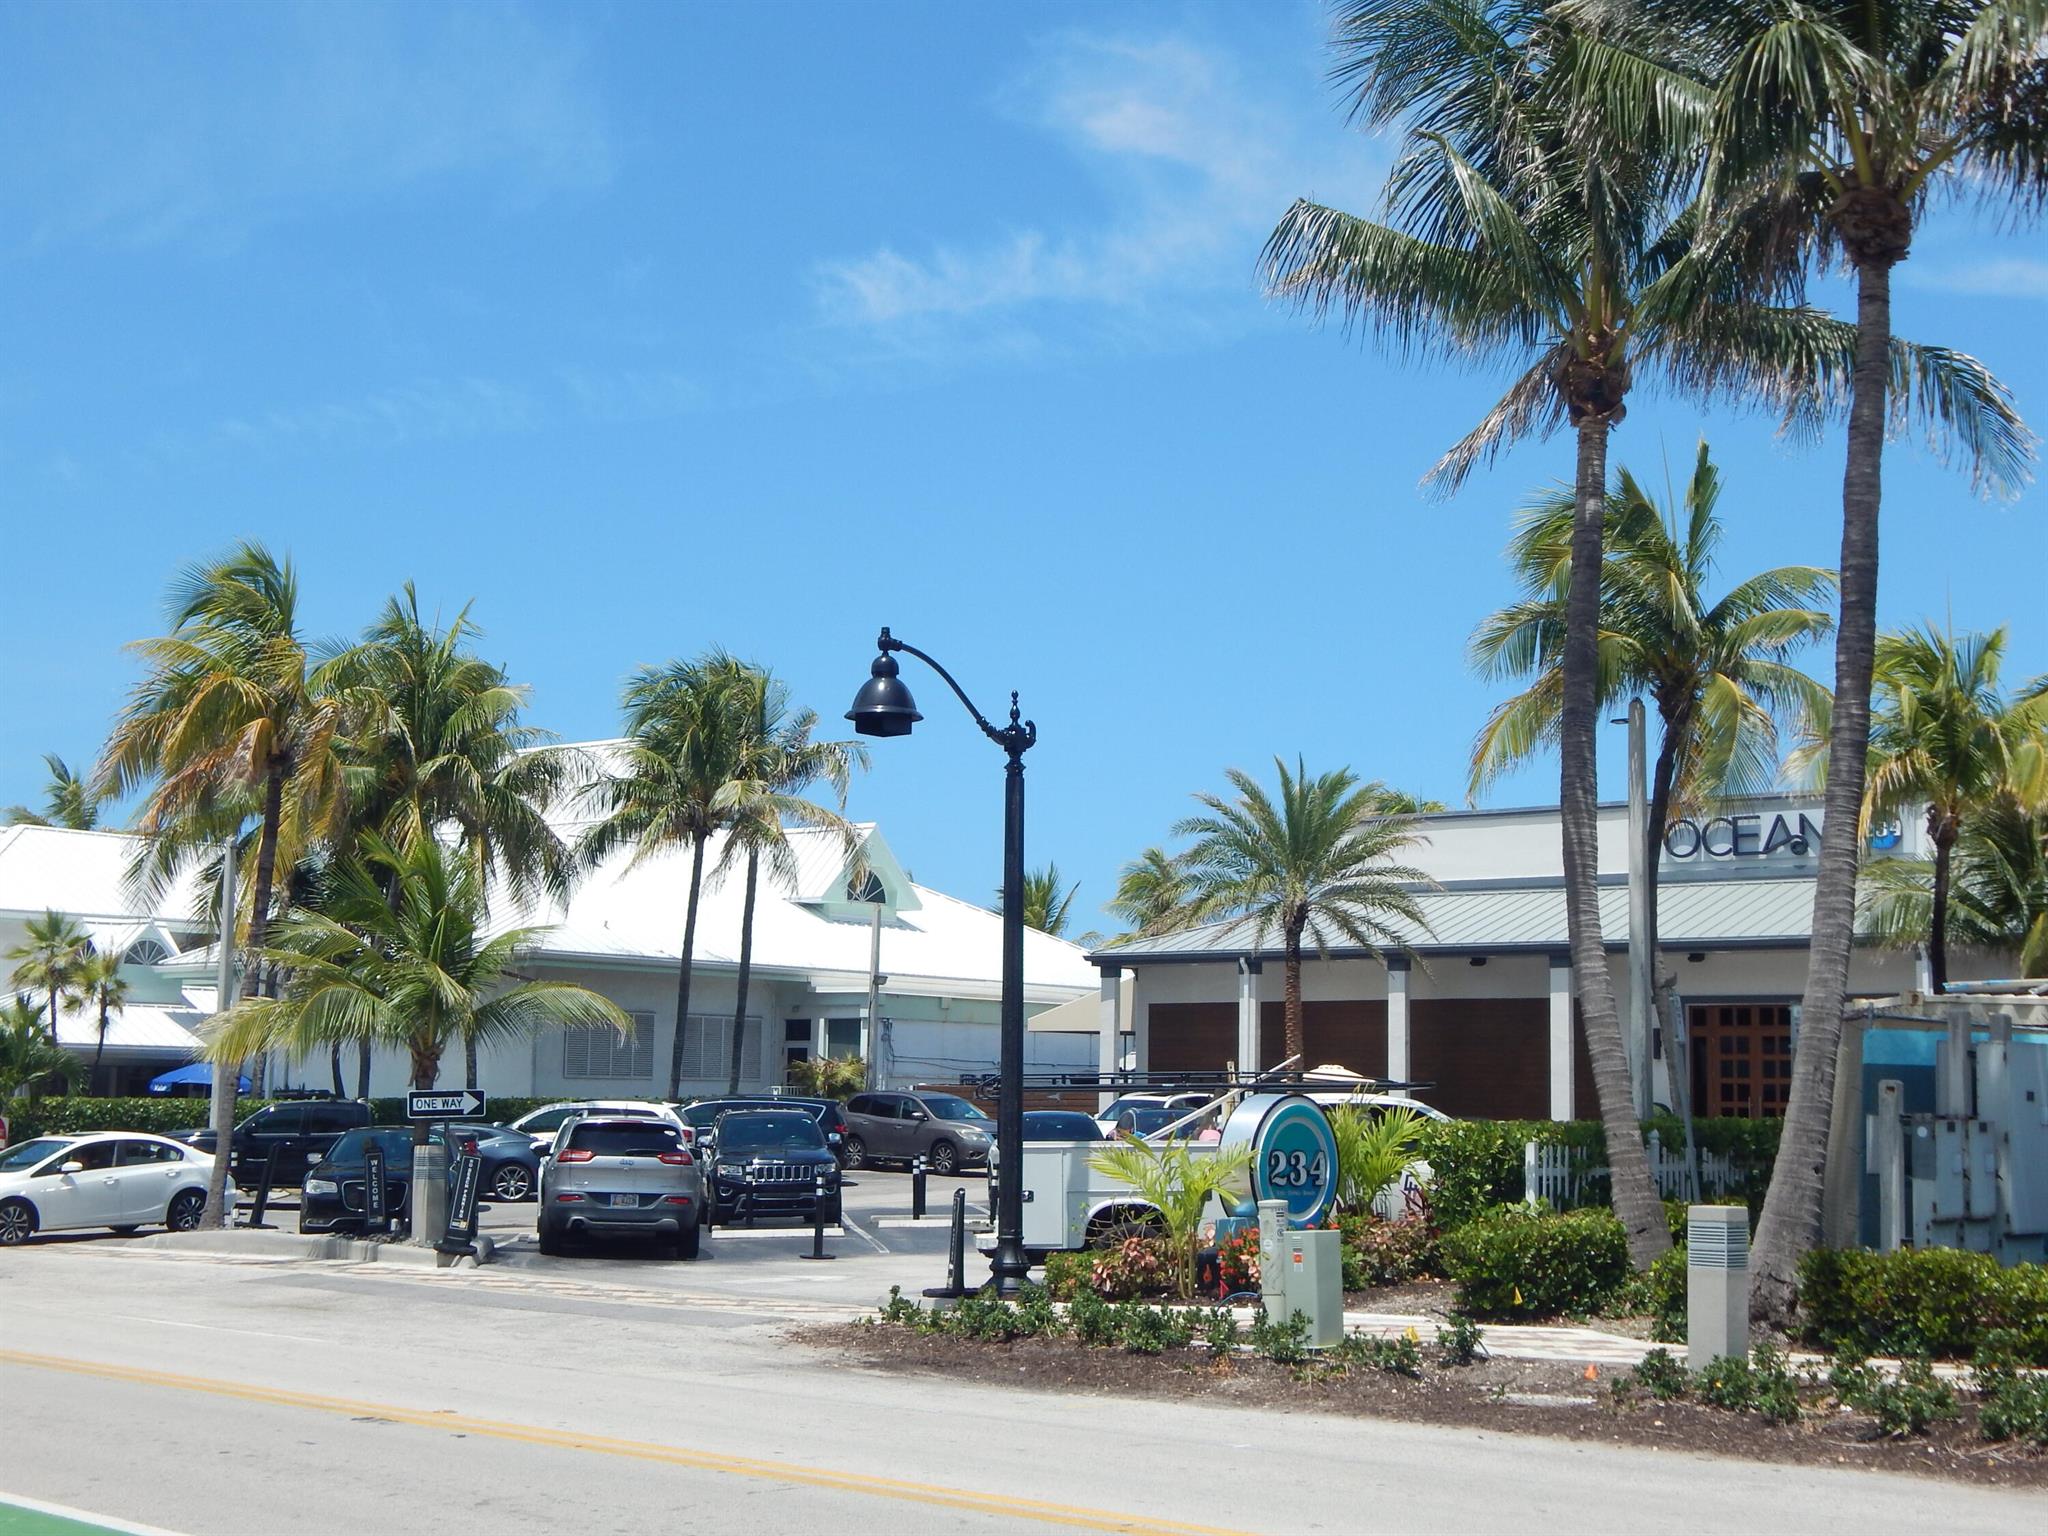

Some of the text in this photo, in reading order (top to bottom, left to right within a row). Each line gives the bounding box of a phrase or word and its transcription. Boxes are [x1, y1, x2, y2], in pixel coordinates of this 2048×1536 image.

[1869, 817, 1902, 837] 34
[415, 1098, 464, 1109] ONE WAY
[1268, 1149, 1327, 1187] 234
[370, 1159, 380, 1209] WELCOME
